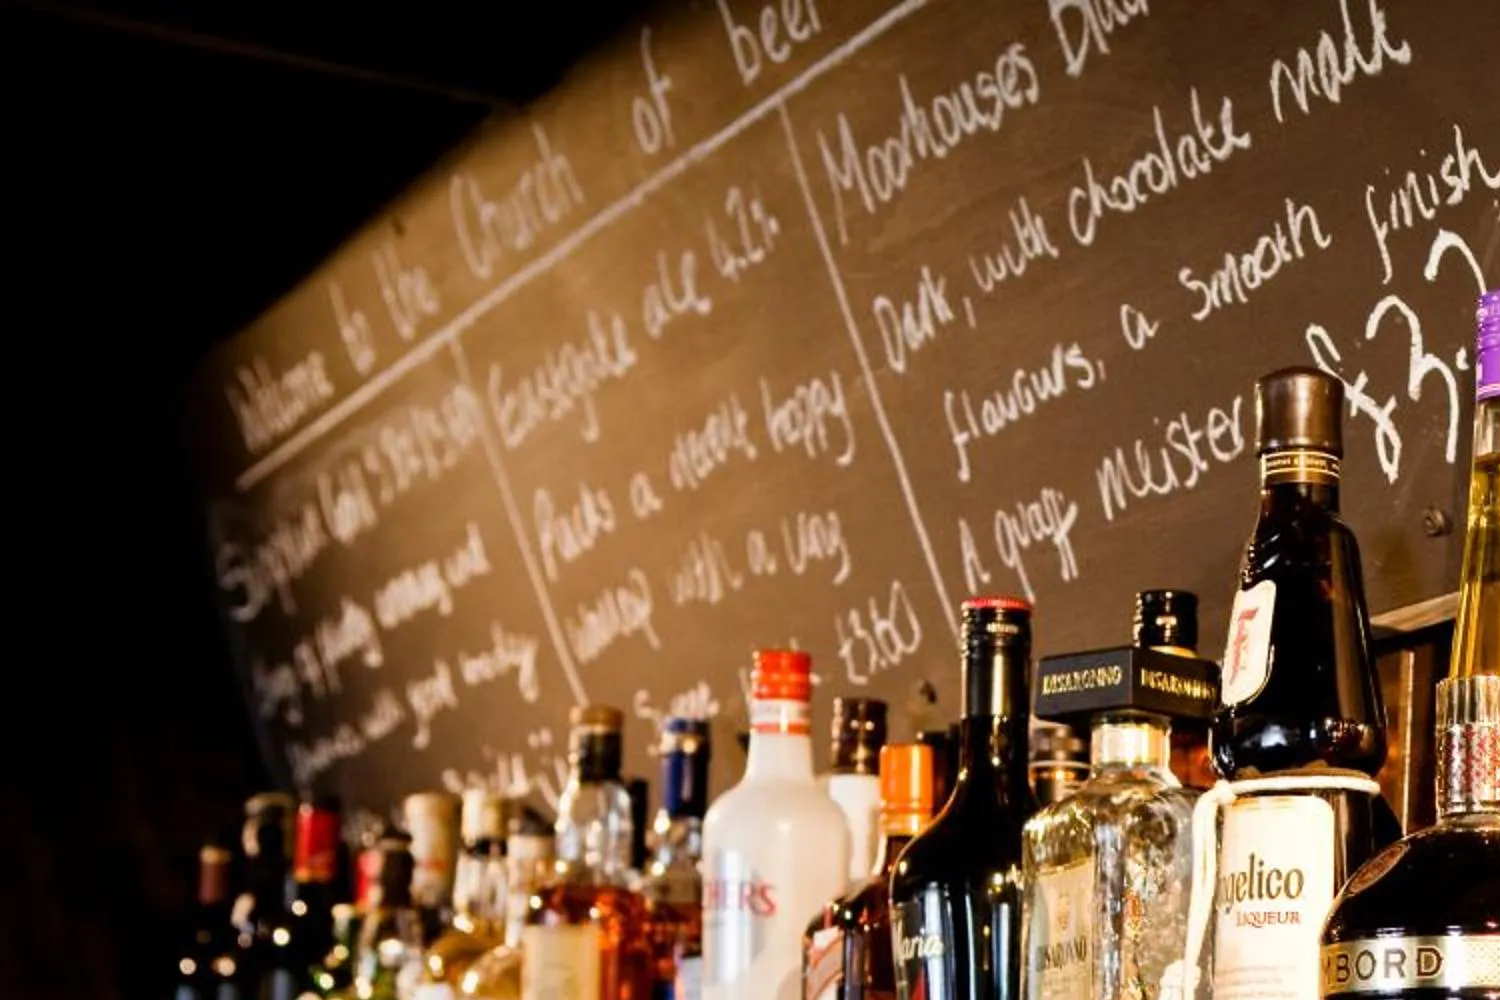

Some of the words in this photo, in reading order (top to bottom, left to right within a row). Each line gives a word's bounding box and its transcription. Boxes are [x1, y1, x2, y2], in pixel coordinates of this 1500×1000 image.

[632, 25, 673, 154] of
[1068, 86, 1251, 247] chocolate
[1121, 303, 1159, 350] a
